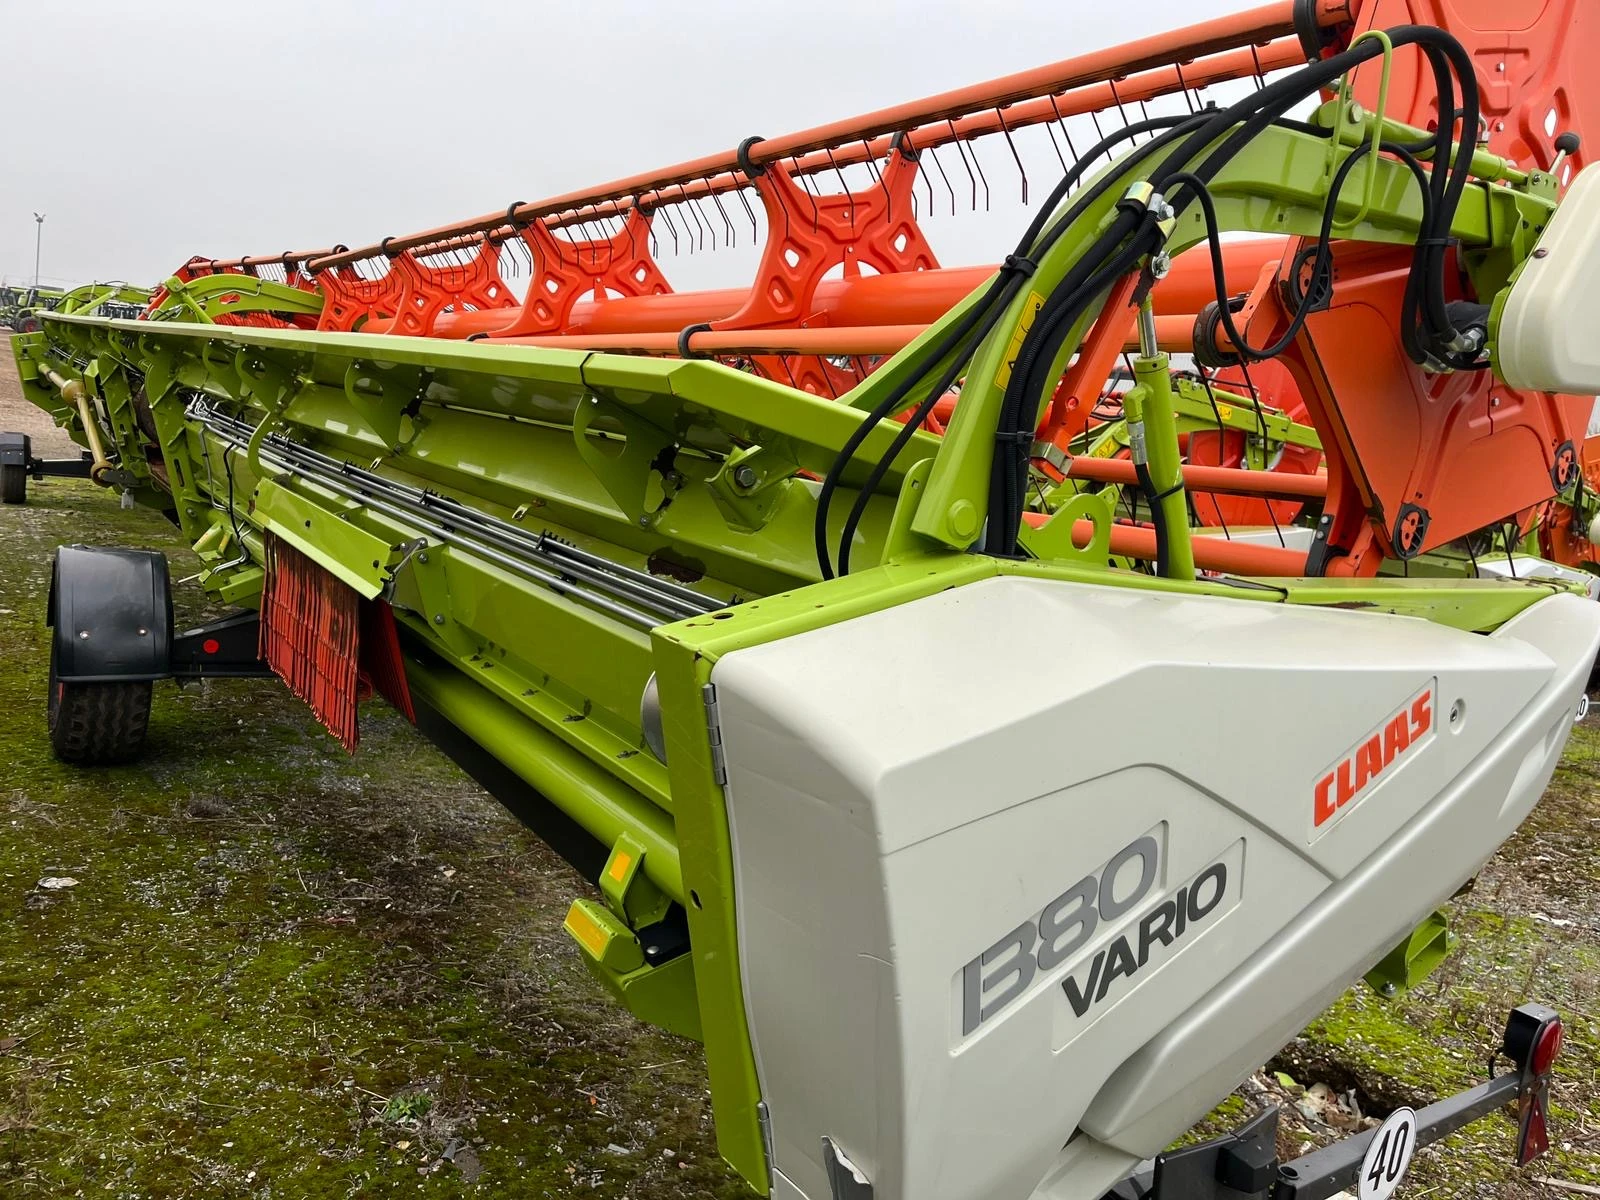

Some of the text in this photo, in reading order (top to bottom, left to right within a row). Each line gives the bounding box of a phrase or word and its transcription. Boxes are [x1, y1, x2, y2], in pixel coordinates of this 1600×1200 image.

[1314, 690, 1431, 826] CLAAS
[1062, 863, 1227, 1018] VARIO
[1368, 1122, 1409, 1191] 40
